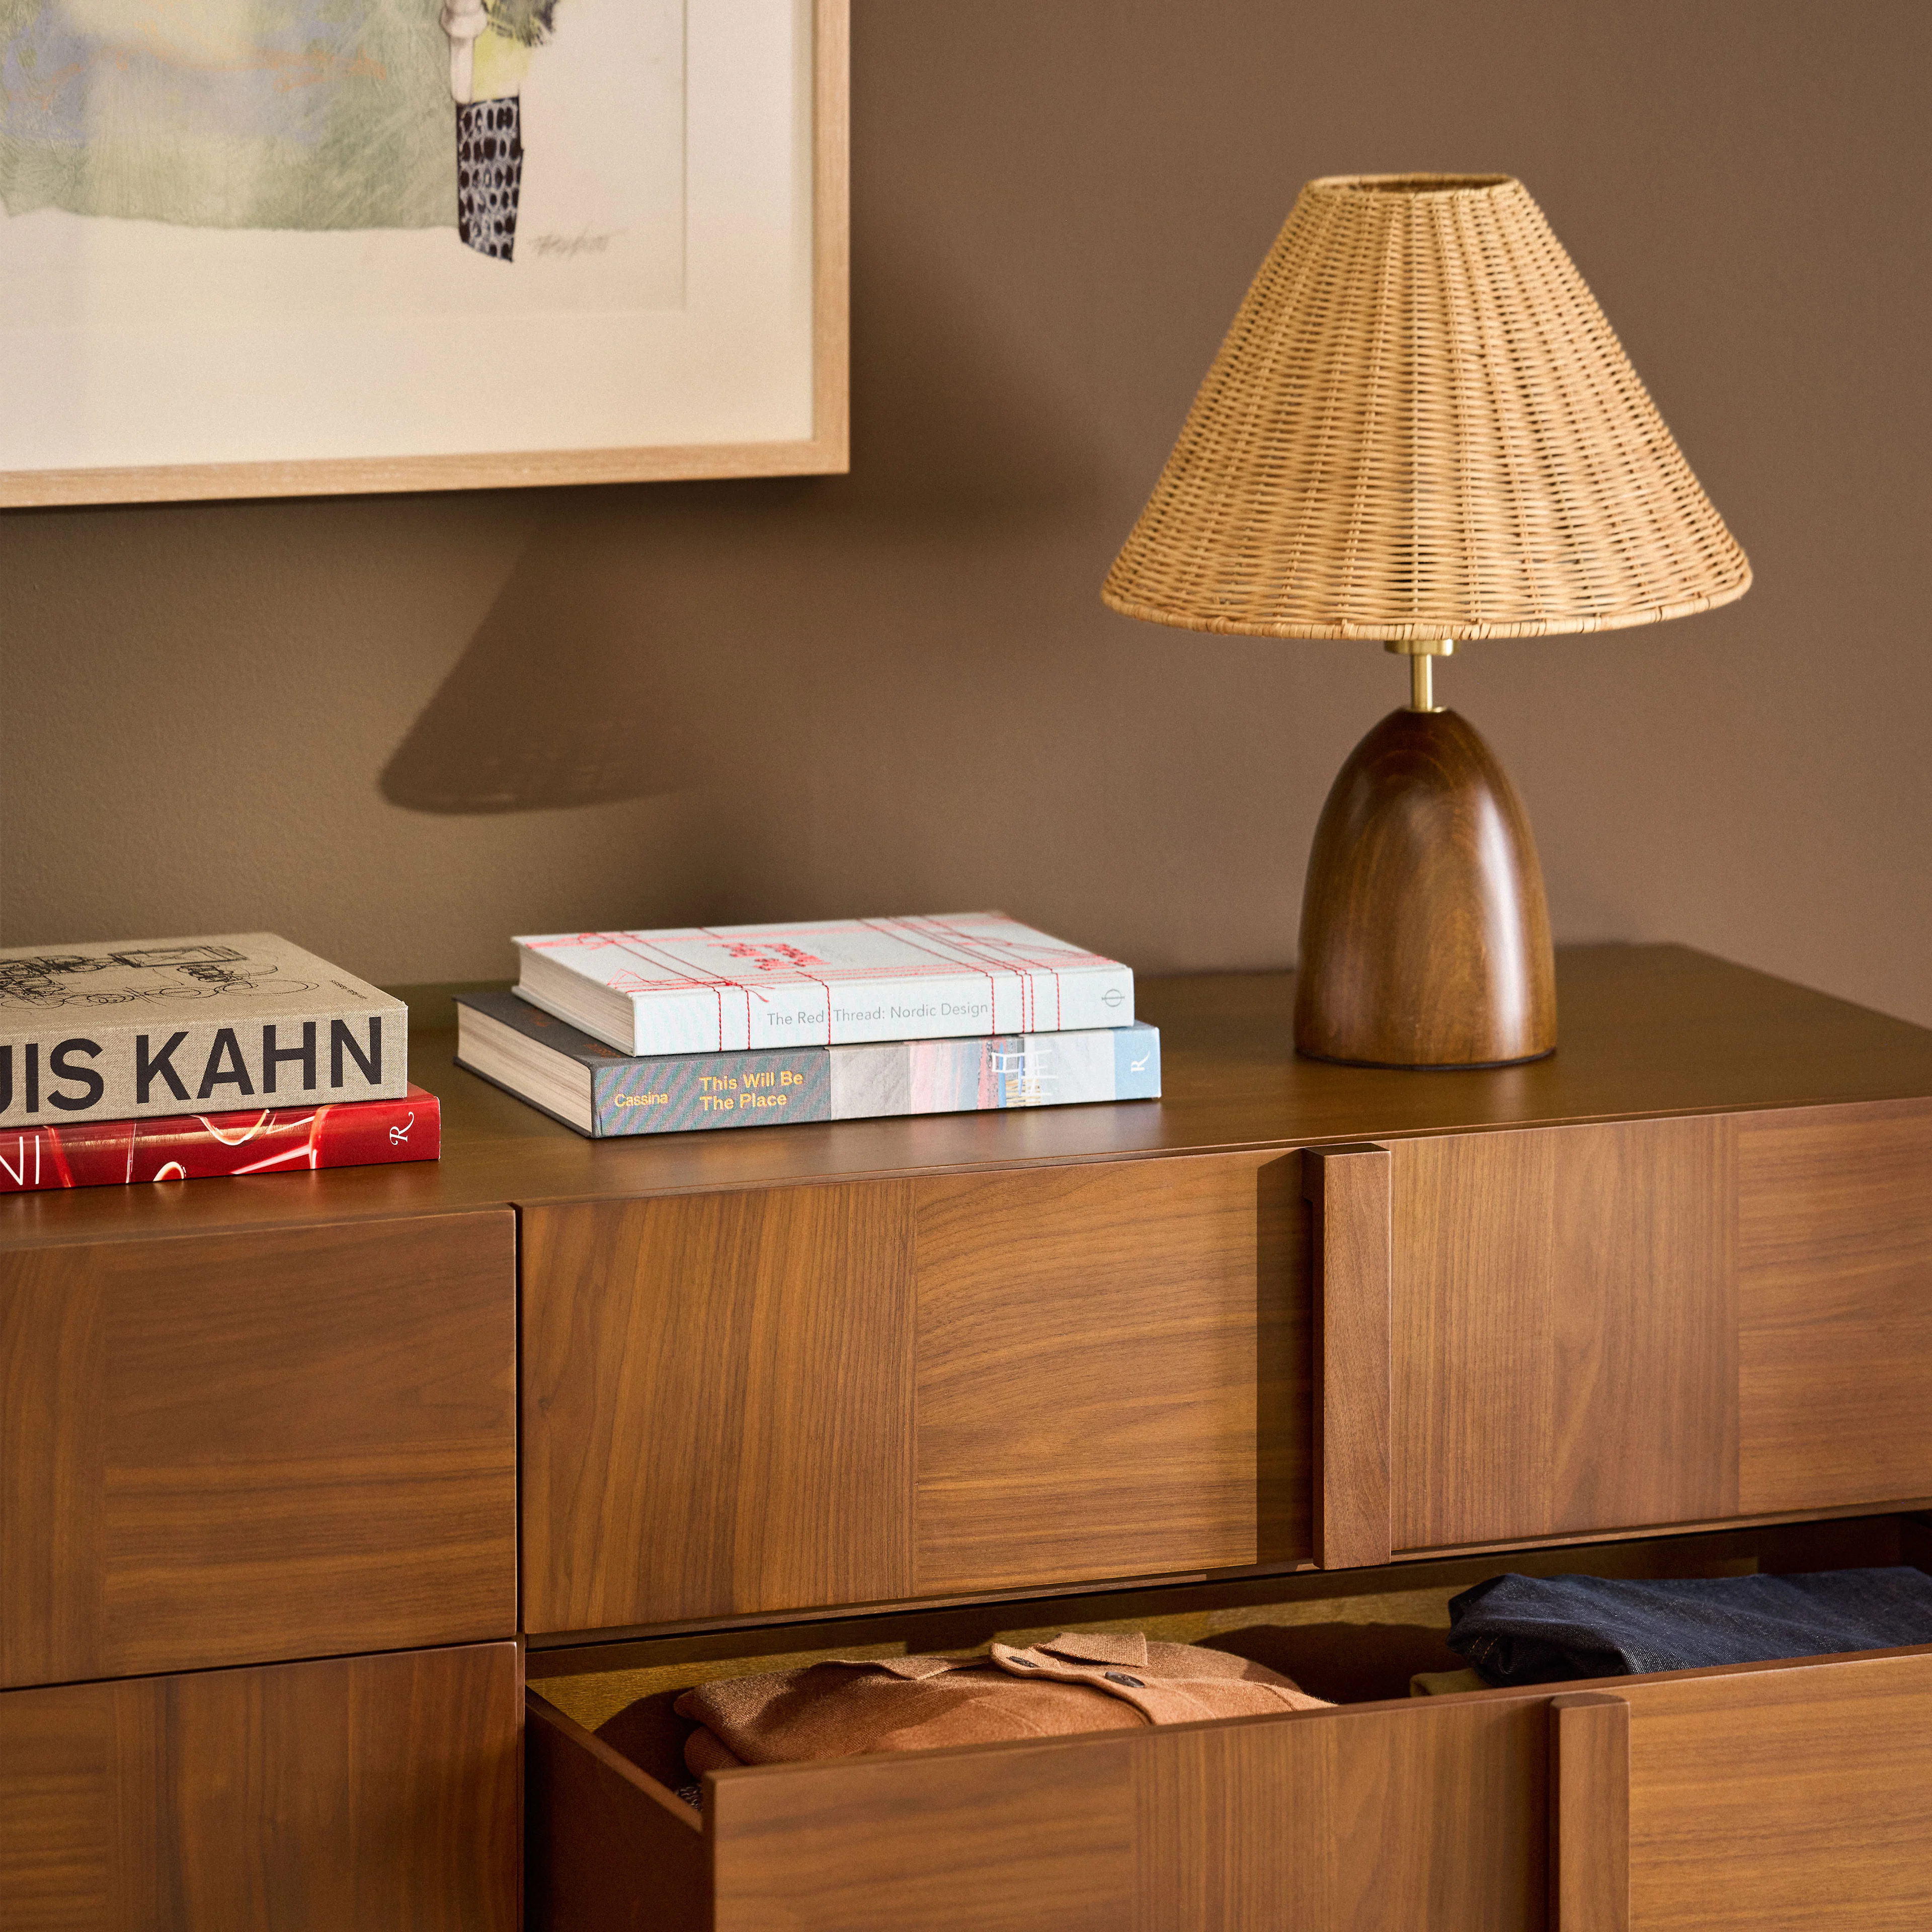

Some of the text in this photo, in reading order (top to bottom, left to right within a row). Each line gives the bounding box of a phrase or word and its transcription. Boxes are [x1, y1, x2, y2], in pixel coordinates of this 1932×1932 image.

[767, 1002, 988, 1025] The Red Thread: Nordic Design
[136, 1017, 381, 1104] KAHN
[699, 1071, 804, 1091] This Will Be
[614, 1091, 669, 1107] Cassina
[699, 1093, 788, 1111] The Place
